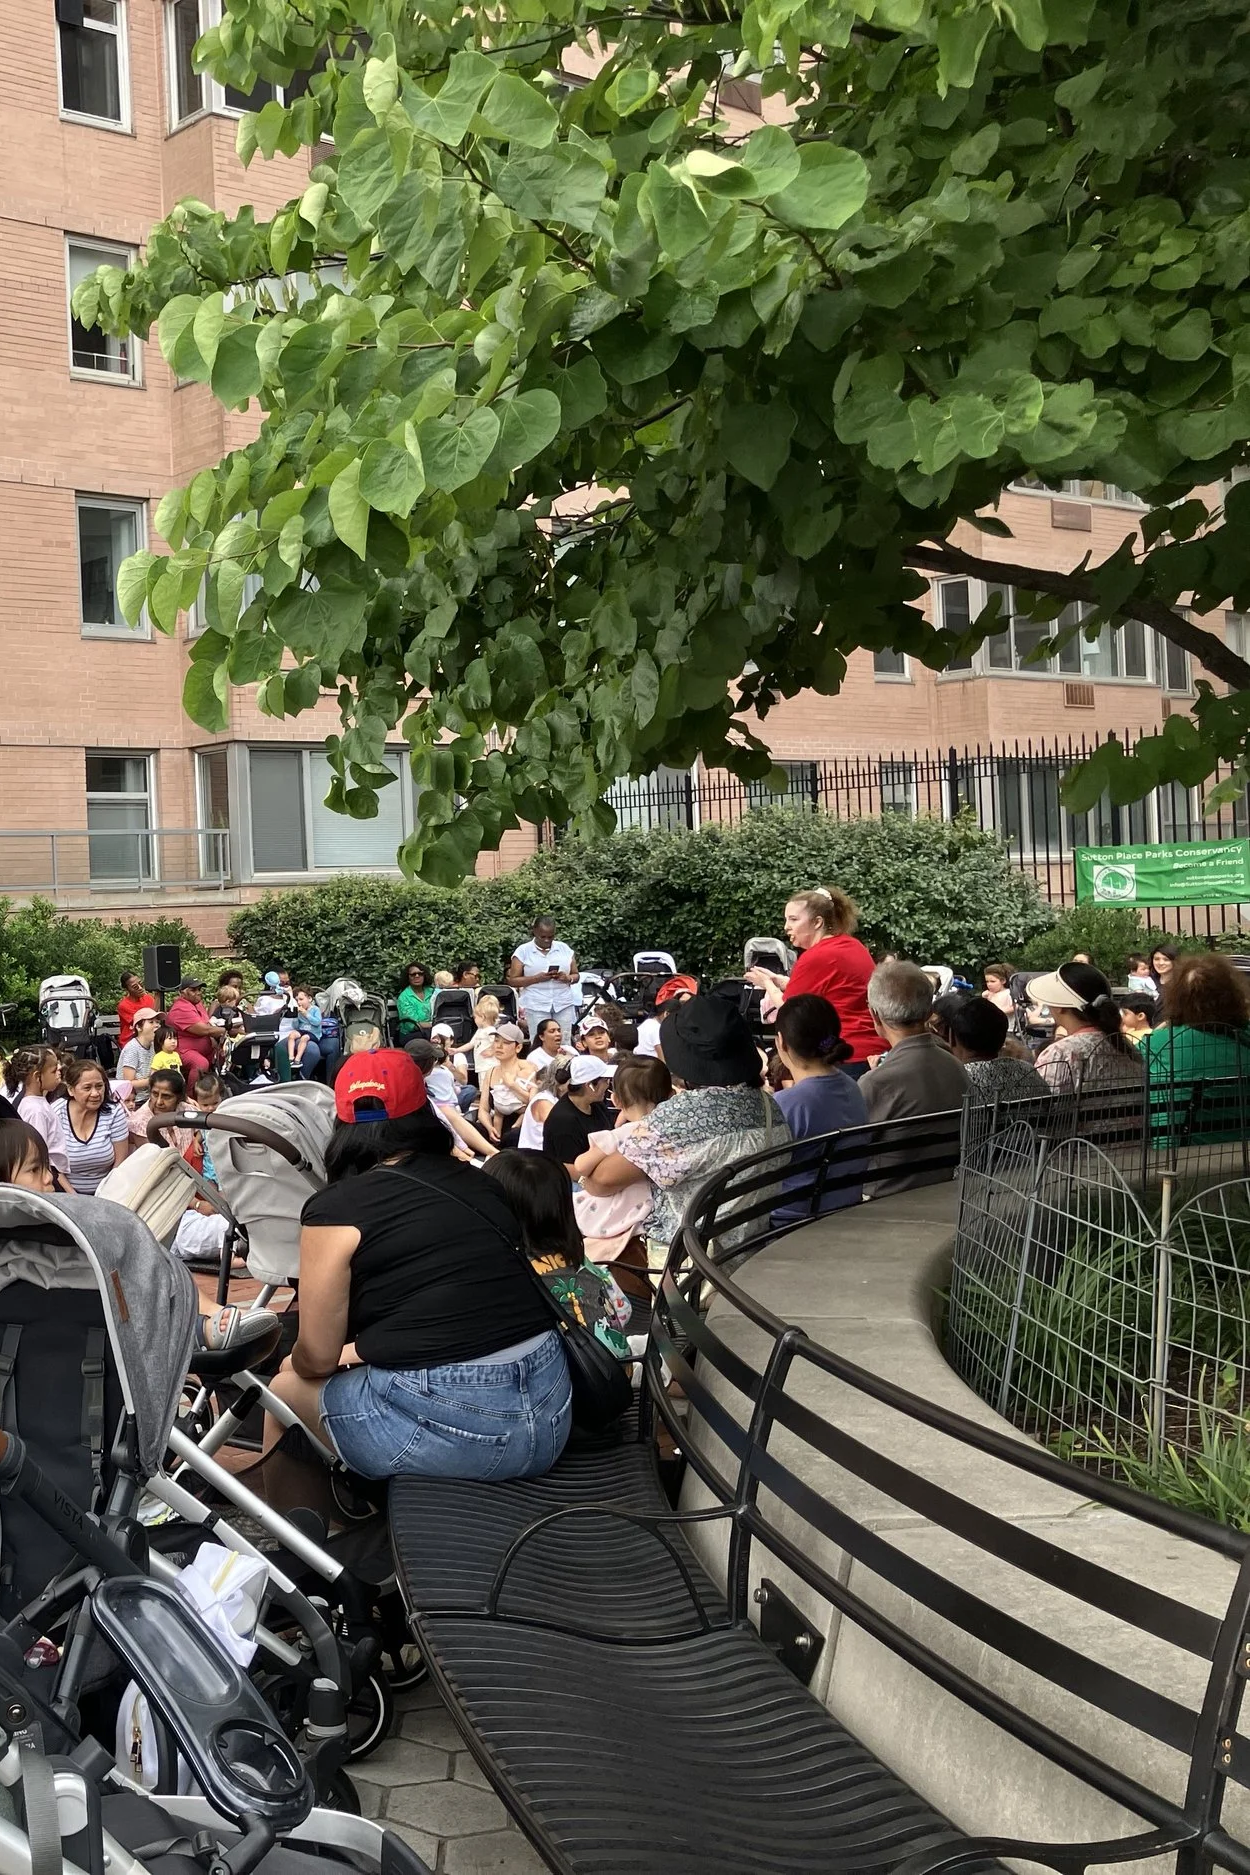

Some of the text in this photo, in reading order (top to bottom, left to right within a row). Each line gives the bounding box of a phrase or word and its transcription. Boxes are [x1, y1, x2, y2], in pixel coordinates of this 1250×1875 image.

[1081, 846, 1242, 862] Sutton Place Parks Conservancy
[1173, 861, 1207, 869] Become
[1216, 857, 1244, 866] Friend
[54, 1490, 83, 1530] VISTA
